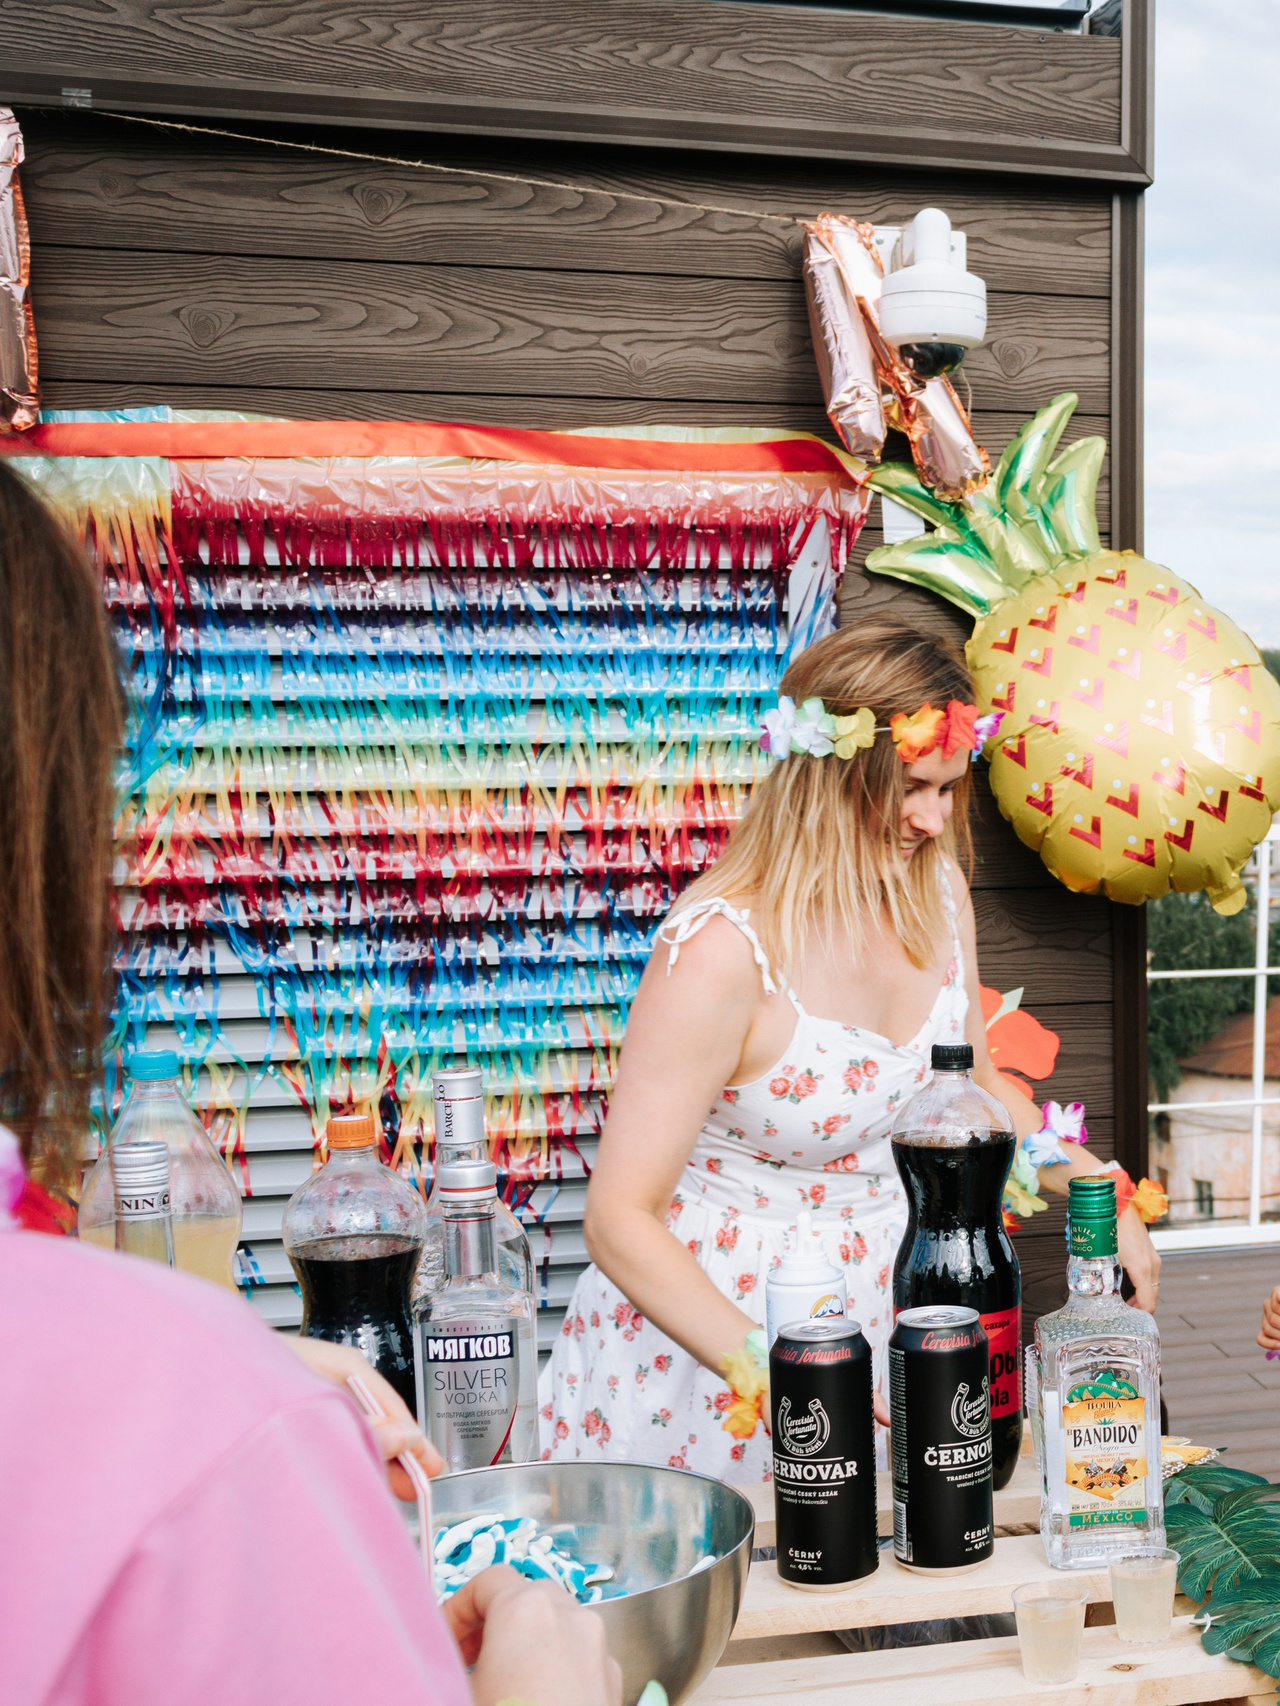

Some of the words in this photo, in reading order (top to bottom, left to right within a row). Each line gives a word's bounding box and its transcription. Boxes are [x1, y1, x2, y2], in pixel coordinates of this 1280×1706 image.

[428, 1335, 511, 1360] МЯГКОВ
[434, 1367, 508, 1391] SILVER
[444, 1391, 498, 1405] VODKA
[1073, 1425, 1137, 1448] BANDIDO
[788, 1547, 823, 1560] ČERNÝ
